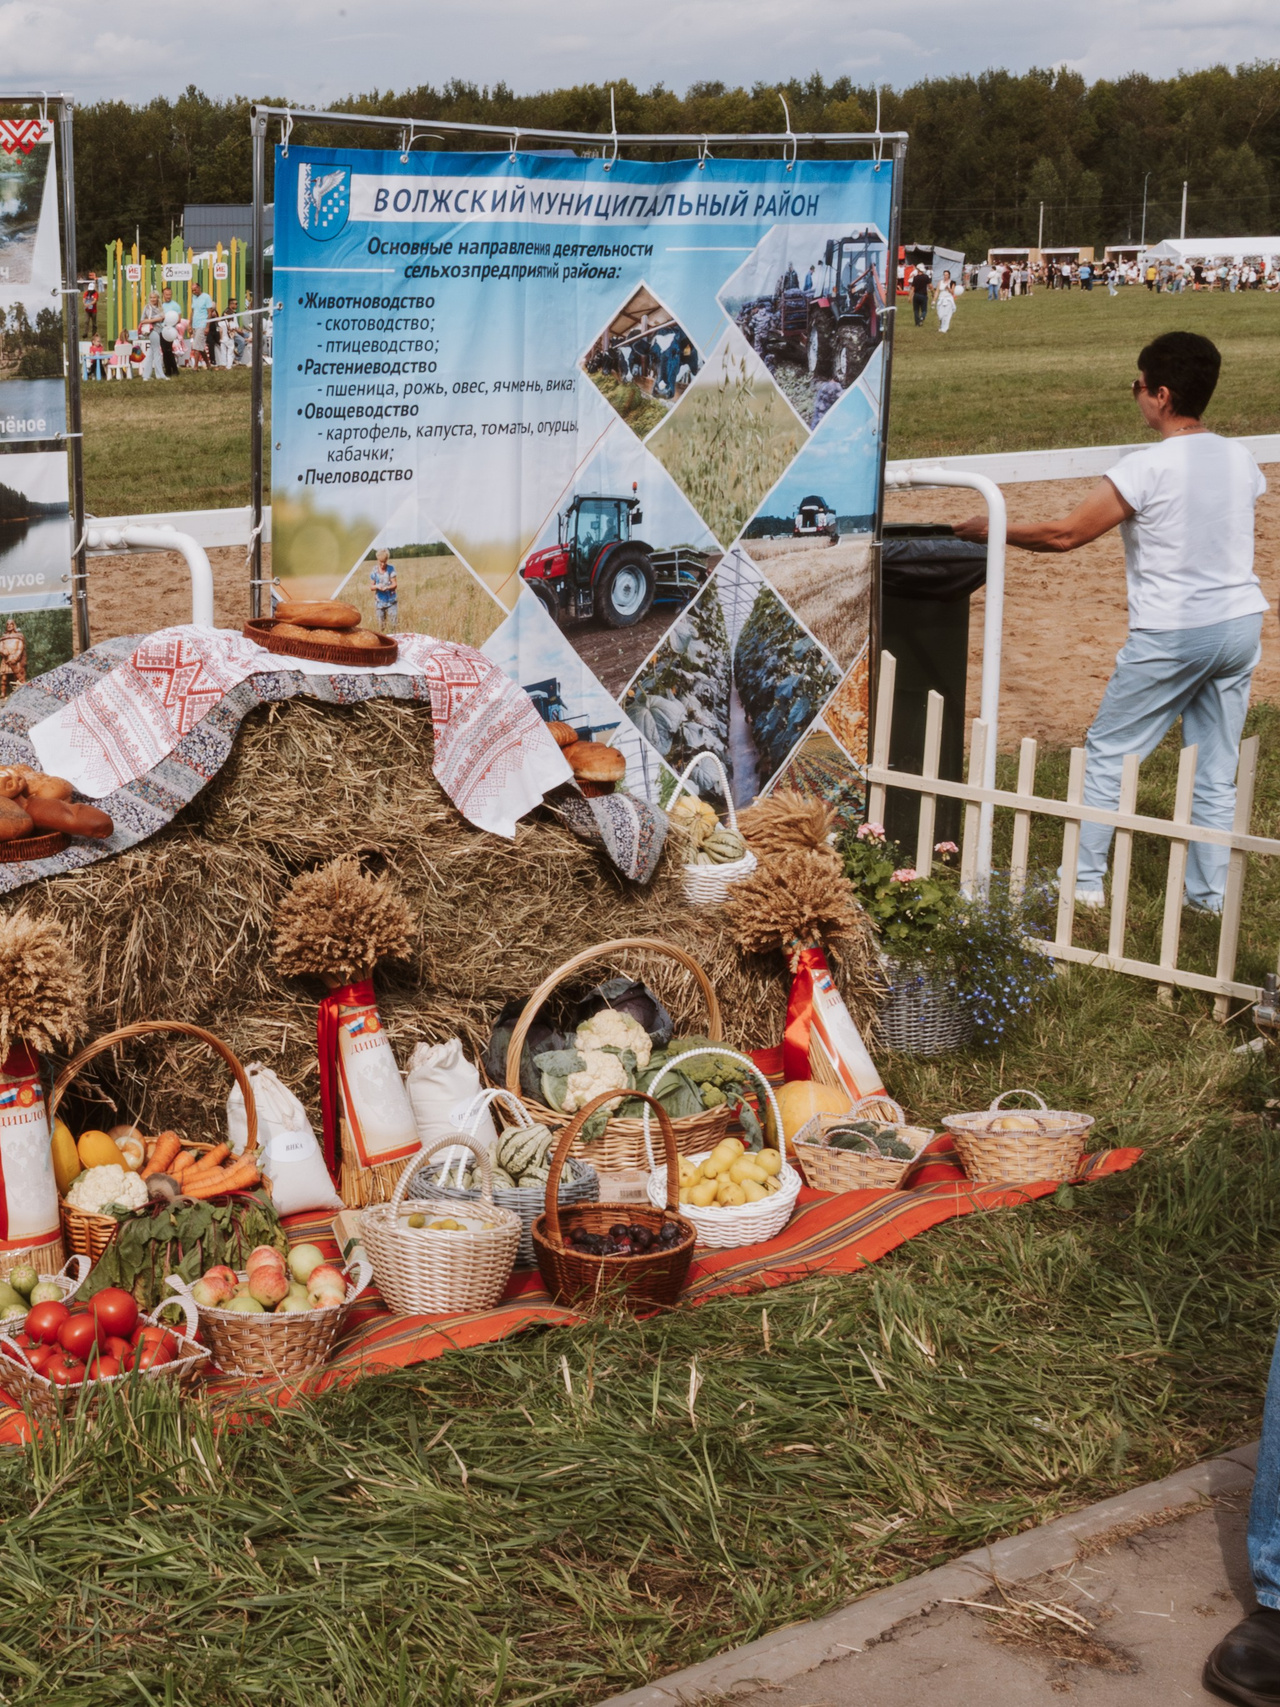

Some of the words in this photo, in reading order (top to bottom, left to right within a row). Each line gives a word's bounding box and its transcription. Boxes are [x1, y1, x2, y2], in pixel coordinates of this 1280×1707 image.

[374, 184, 526, 214] ВОЛЖСКИЙ
[530, 189, 749, 220] МУНИЦИПАЛЬНЫЙ
[753, 189, 820, 217] РАЙОН
[368, 236, 452, 255] Основные
[458, 241, 551, 259] направления
[553, 243, 654, 259] деятельности
[404, 262, 559, 282] сельхозпредприятий
[563, 262, 622, 283] района:
[304, 292, 435, 311] Животноводство
[325, 318, 436, 333] скотоводство;
[326, 339, 440, 355] птицеводство;
[304, 358, 437, 376] Растениеводство
[325, 381, 400, 397] пшеница,
[403, 381, 448, 400] рожь,
[452, 381, 489, 396] овес,
[492, 380, 544, 396] ячмень,
[546, 379, 576, 393] вика;
[304, 403, 419, 421] Овощеводство
[326, 423, 412, 444] картофель,
[416, 424, 477, 441] капуста,
[481, 422, 534, 437] томаты,
[327, 446, 394, 463] кабачки;
[305, 468, 413, 485] Пчеловодство
